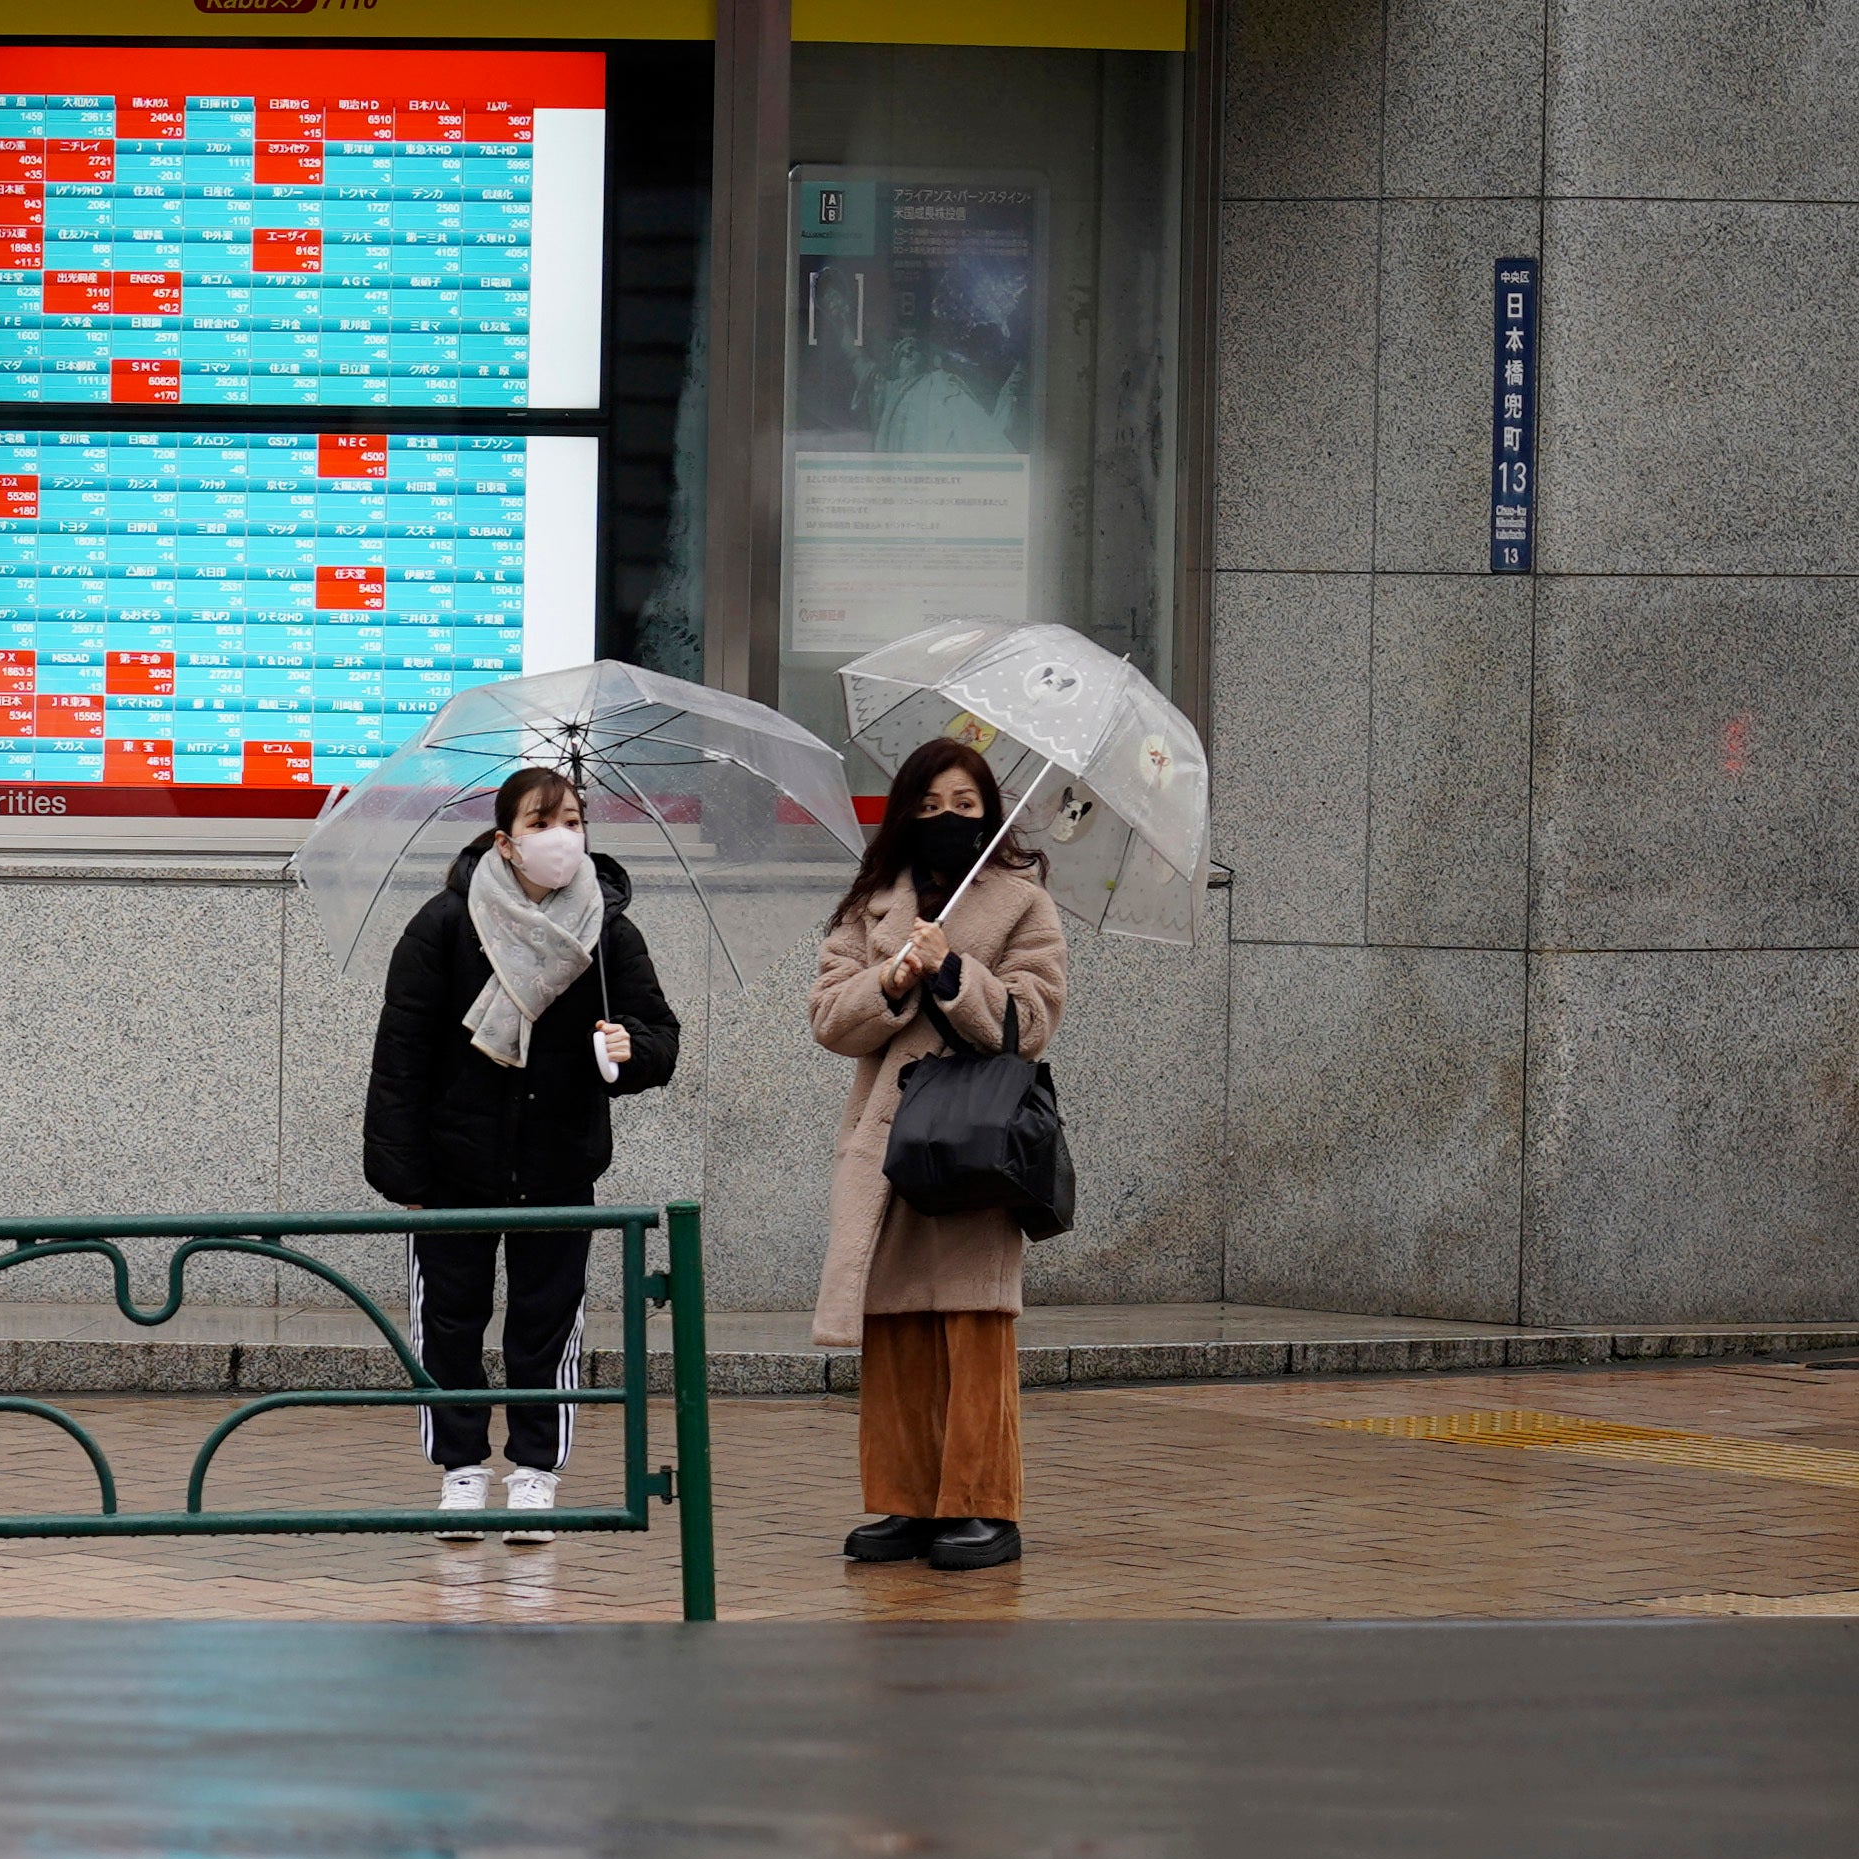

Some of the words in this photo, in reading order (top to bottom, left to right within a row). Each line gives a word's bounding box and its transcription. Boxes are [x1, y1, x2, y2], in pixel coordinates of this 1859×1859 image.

[339, 100, 379, 110] 明治HD
[409, 100, 450, 110] 日本ハム
[150, 112, 183, 122] 2404.0
[299, 114, 322, 124] 1597
[438, 115, 462, 125] 3590
[508, 116, 532, 126] 3607
[60, 141, 100, 151] ニチレイ
[18, 155, 42, 165] 4034
[88, 156, 111, 166] 2721
[298, 158, 322, 168] 1329
[339, 188, 379, 198] トクヤマ
[411, 188, 444, 199] デンカ
[24, 199, 42, 209] 943
[267, 231, 308, 241] エーザイ
[342, 231, 372, 242] テルモ
[57, 273, 97, 283] 出光興産
[130, 274, 165, 284] ENEOS
[342, 275, 371, 286] AGC
[1500, 270, 1530, 284] 中央区
[86, 288, 110, 297] 3110
[132, 362, 160, 372] SMC
[200, 362, 230, 372] コマツ
[409, 364, 440, 375] クボタ
[1503, 292, 1525, 452] 日本橋兜町
[502, 378, 528, 392] 4770
[193, 435, 234, 446] オムロン
[338, 437, 367, 447] NEC
[471, 437, 513, 449] エプソン
[360, 452, 386, 462] 4500
[1498, 461, 1527, 493] 13
[53, 477, 94, 488] デンソー
[128, 478, 159, 489] カシオ
[7, 492, 36, 501] 55260
[59, 521, 89, 532] トヨタ
[406, 525, 436, 536] スズキ
[469, 526, 512, 537] SUBARU
[1503, 547, 1519, 564] 13
[334, 568, 366, 580] 任天堂
[358, 583, 383, 594] 5453
[56, 608, 87, 619] イオン
[119, 653, 161, 664] 第一生命
[148, 668, 172, 678] 3052
[9, 710, 33, 720] 5344
[74, 712, 102, 721] 15505
[263, 744, 293, 754] セコム
[147, 756, 171, 766] 4615
[286, 758, 310, 768] 7520
